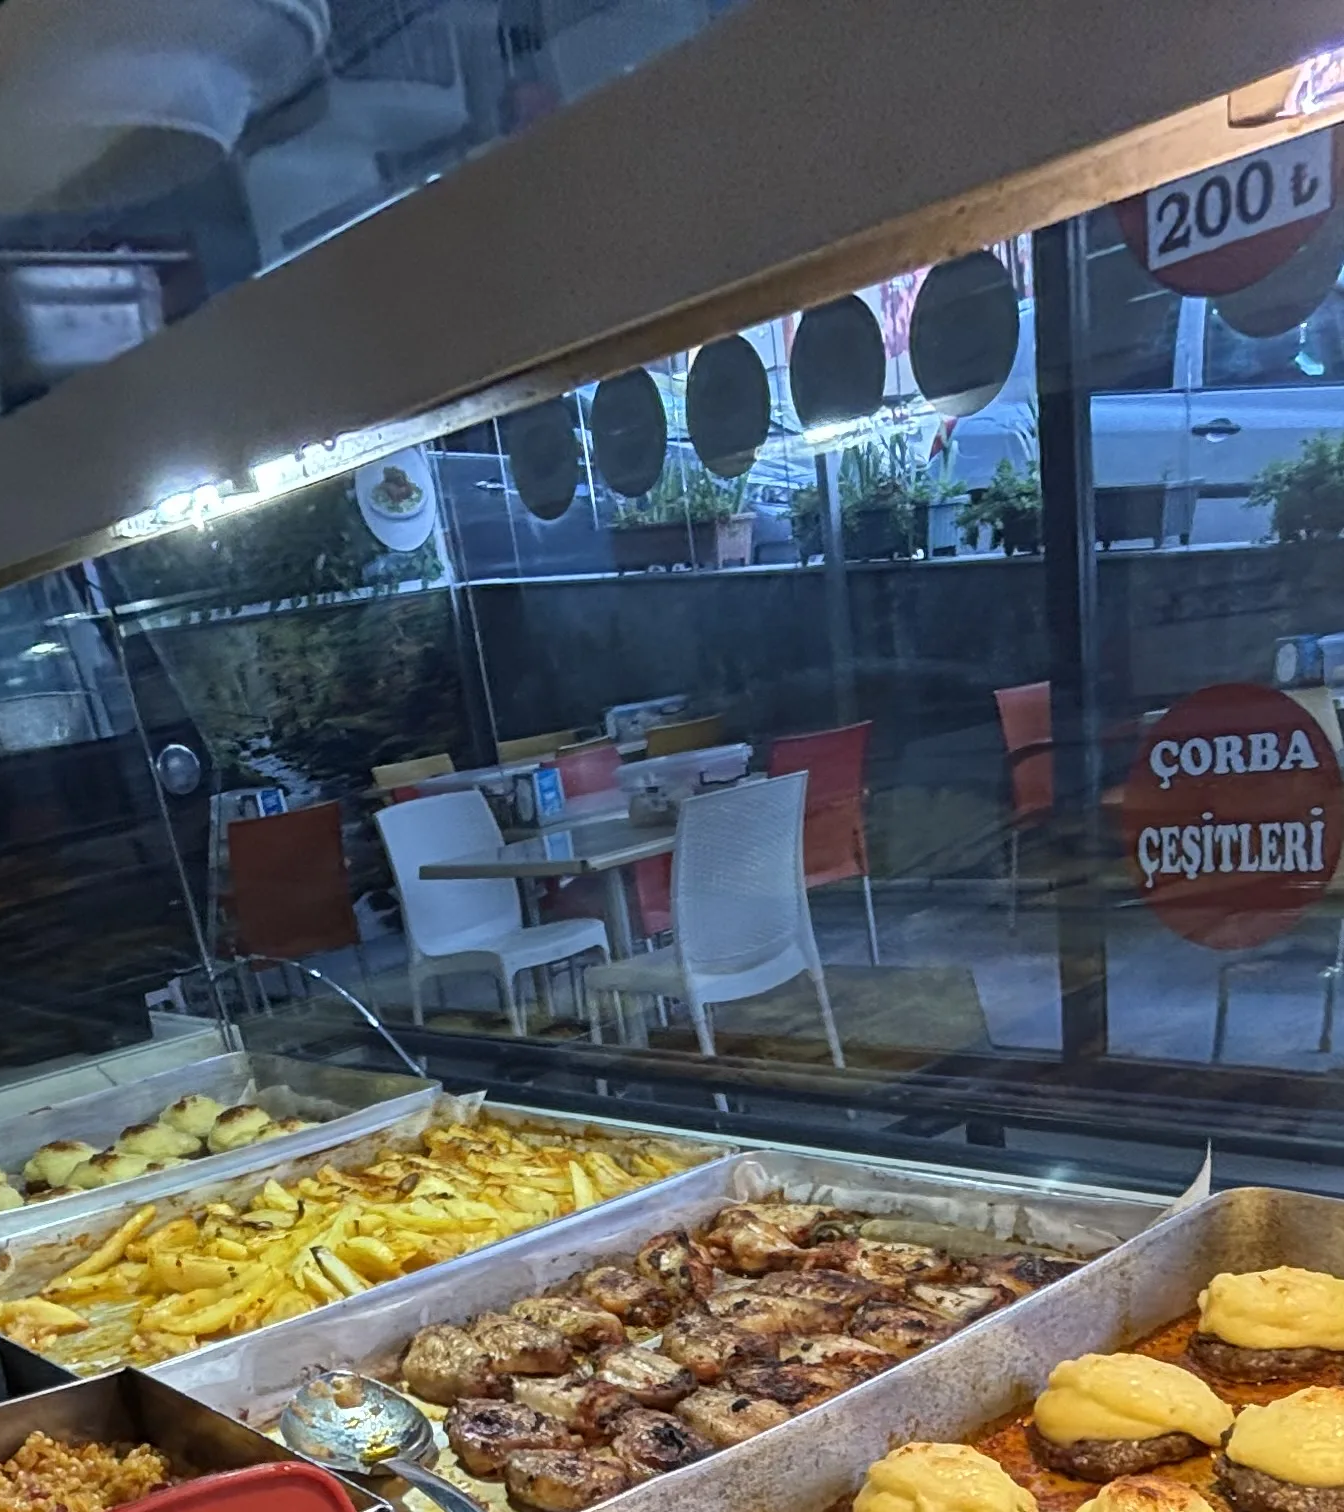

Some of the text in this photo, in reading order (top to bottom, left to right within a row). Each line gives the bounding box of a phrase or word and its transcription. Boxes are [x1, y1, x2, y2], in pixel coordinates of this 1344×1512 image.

[1156, 158, 1274, 255] 200
[1149, 729, 1320, 790] ÇORBA
[1137, 805, 1326, 889] ÇEŞİTLERİ
